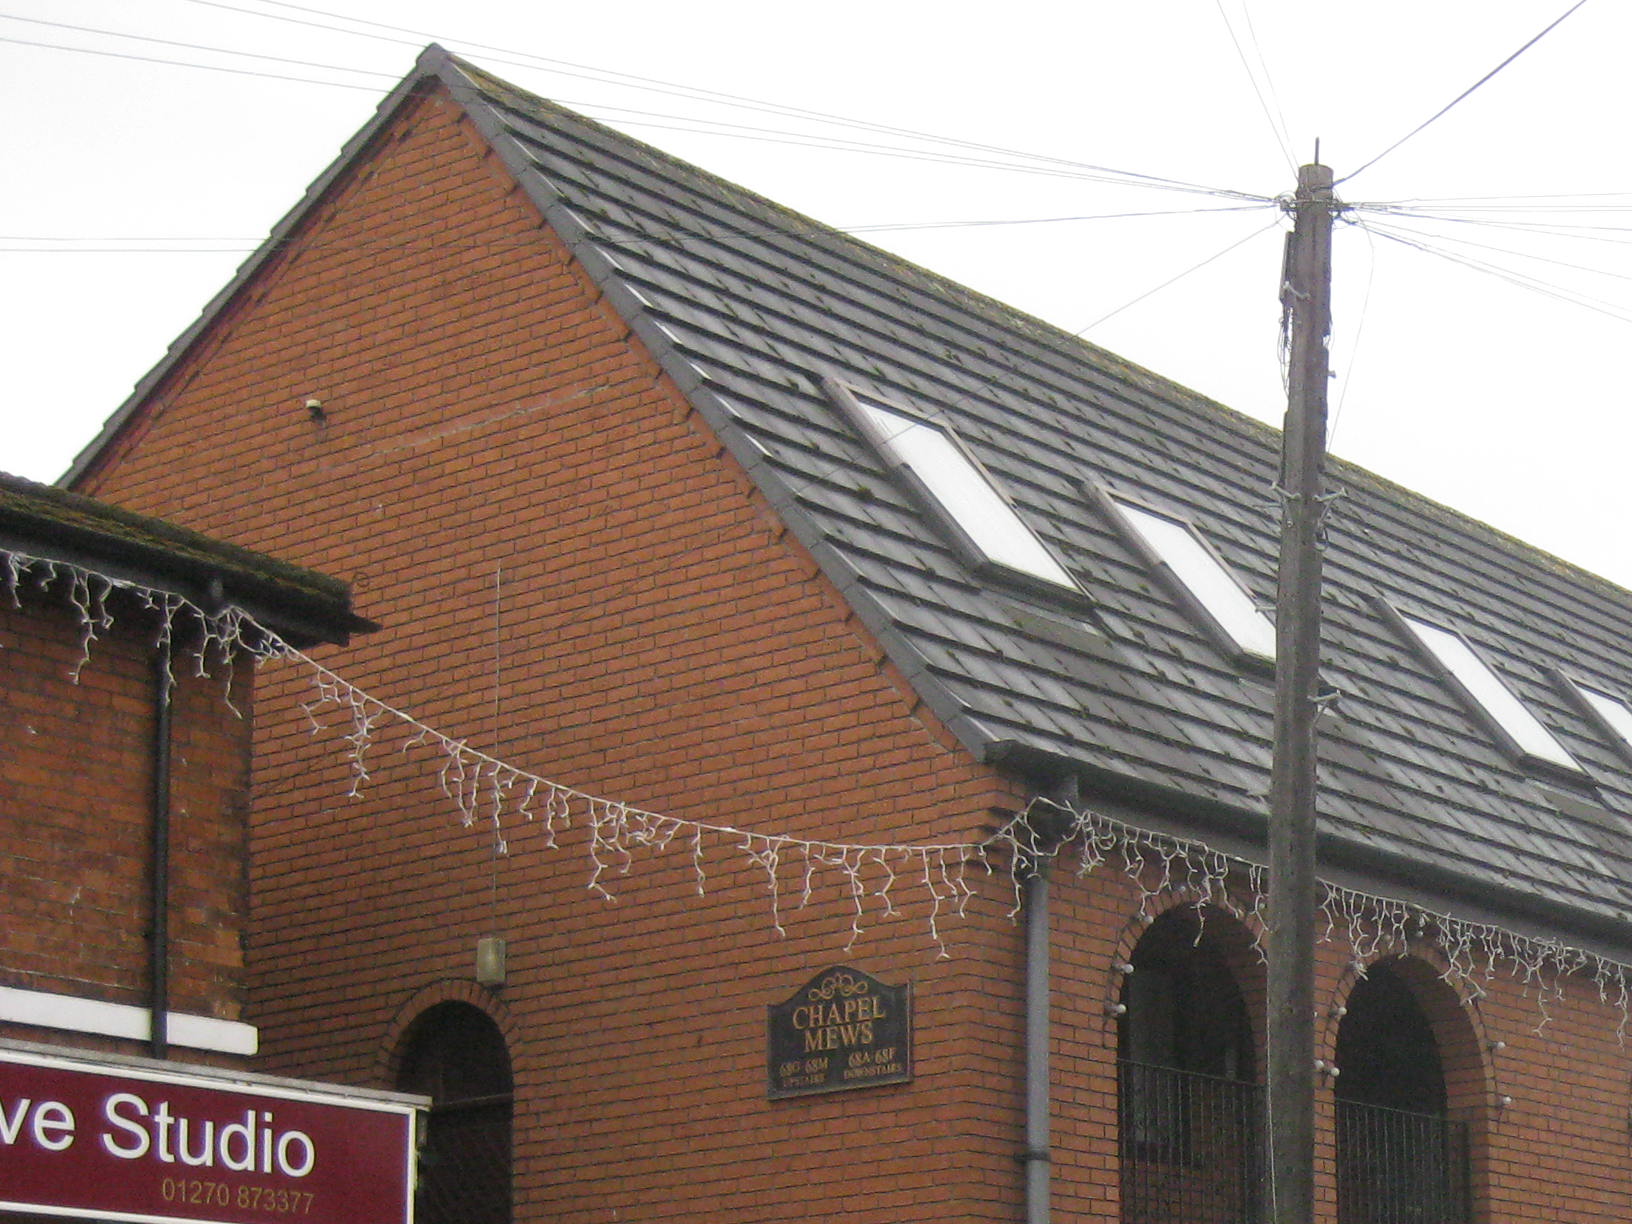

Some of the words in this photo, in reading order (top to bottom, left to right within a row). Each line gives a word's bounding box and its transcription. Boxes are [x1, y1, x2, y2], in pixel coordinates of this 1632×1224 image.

[792, 996, 886, 1030] CHAPEL
[804, 1021, 874, 1052] MEWS
[103, 1092, 316, 1178] Studio
[163, 1178, 230, 1207] 01270
[237, 1185, 315, 1215] 873377
